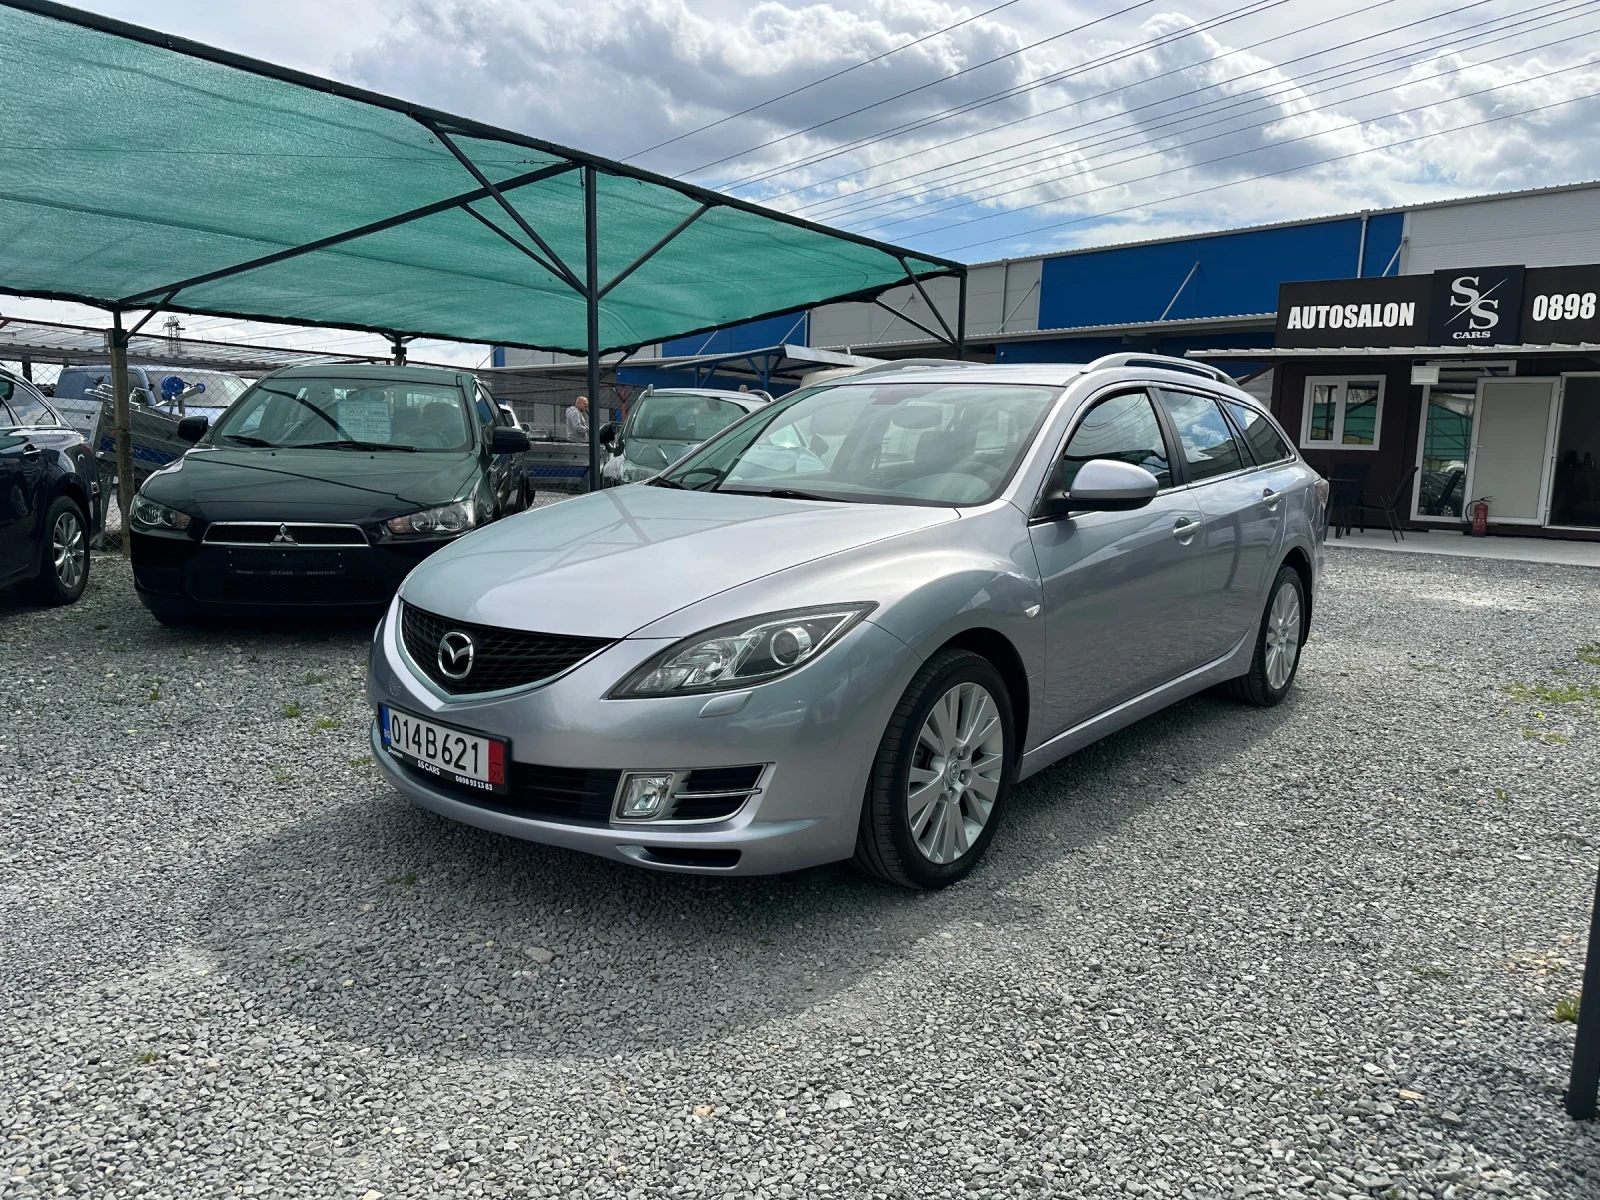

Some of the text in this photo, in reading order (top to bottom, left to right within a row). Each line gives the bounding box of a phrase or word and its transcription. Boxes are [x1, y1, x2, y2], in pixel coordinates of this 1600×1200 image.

[1532, 292, 1597, 322] 0898
[1286, 302, 1416, 329] AUTOSALON
[1452, 330, 1491, 339] CARS
[384, 728, 390, 739] BG
[417, 760, 440, 776] SS CARS
[455, 775, 493, 791] 0898 93 13 83
